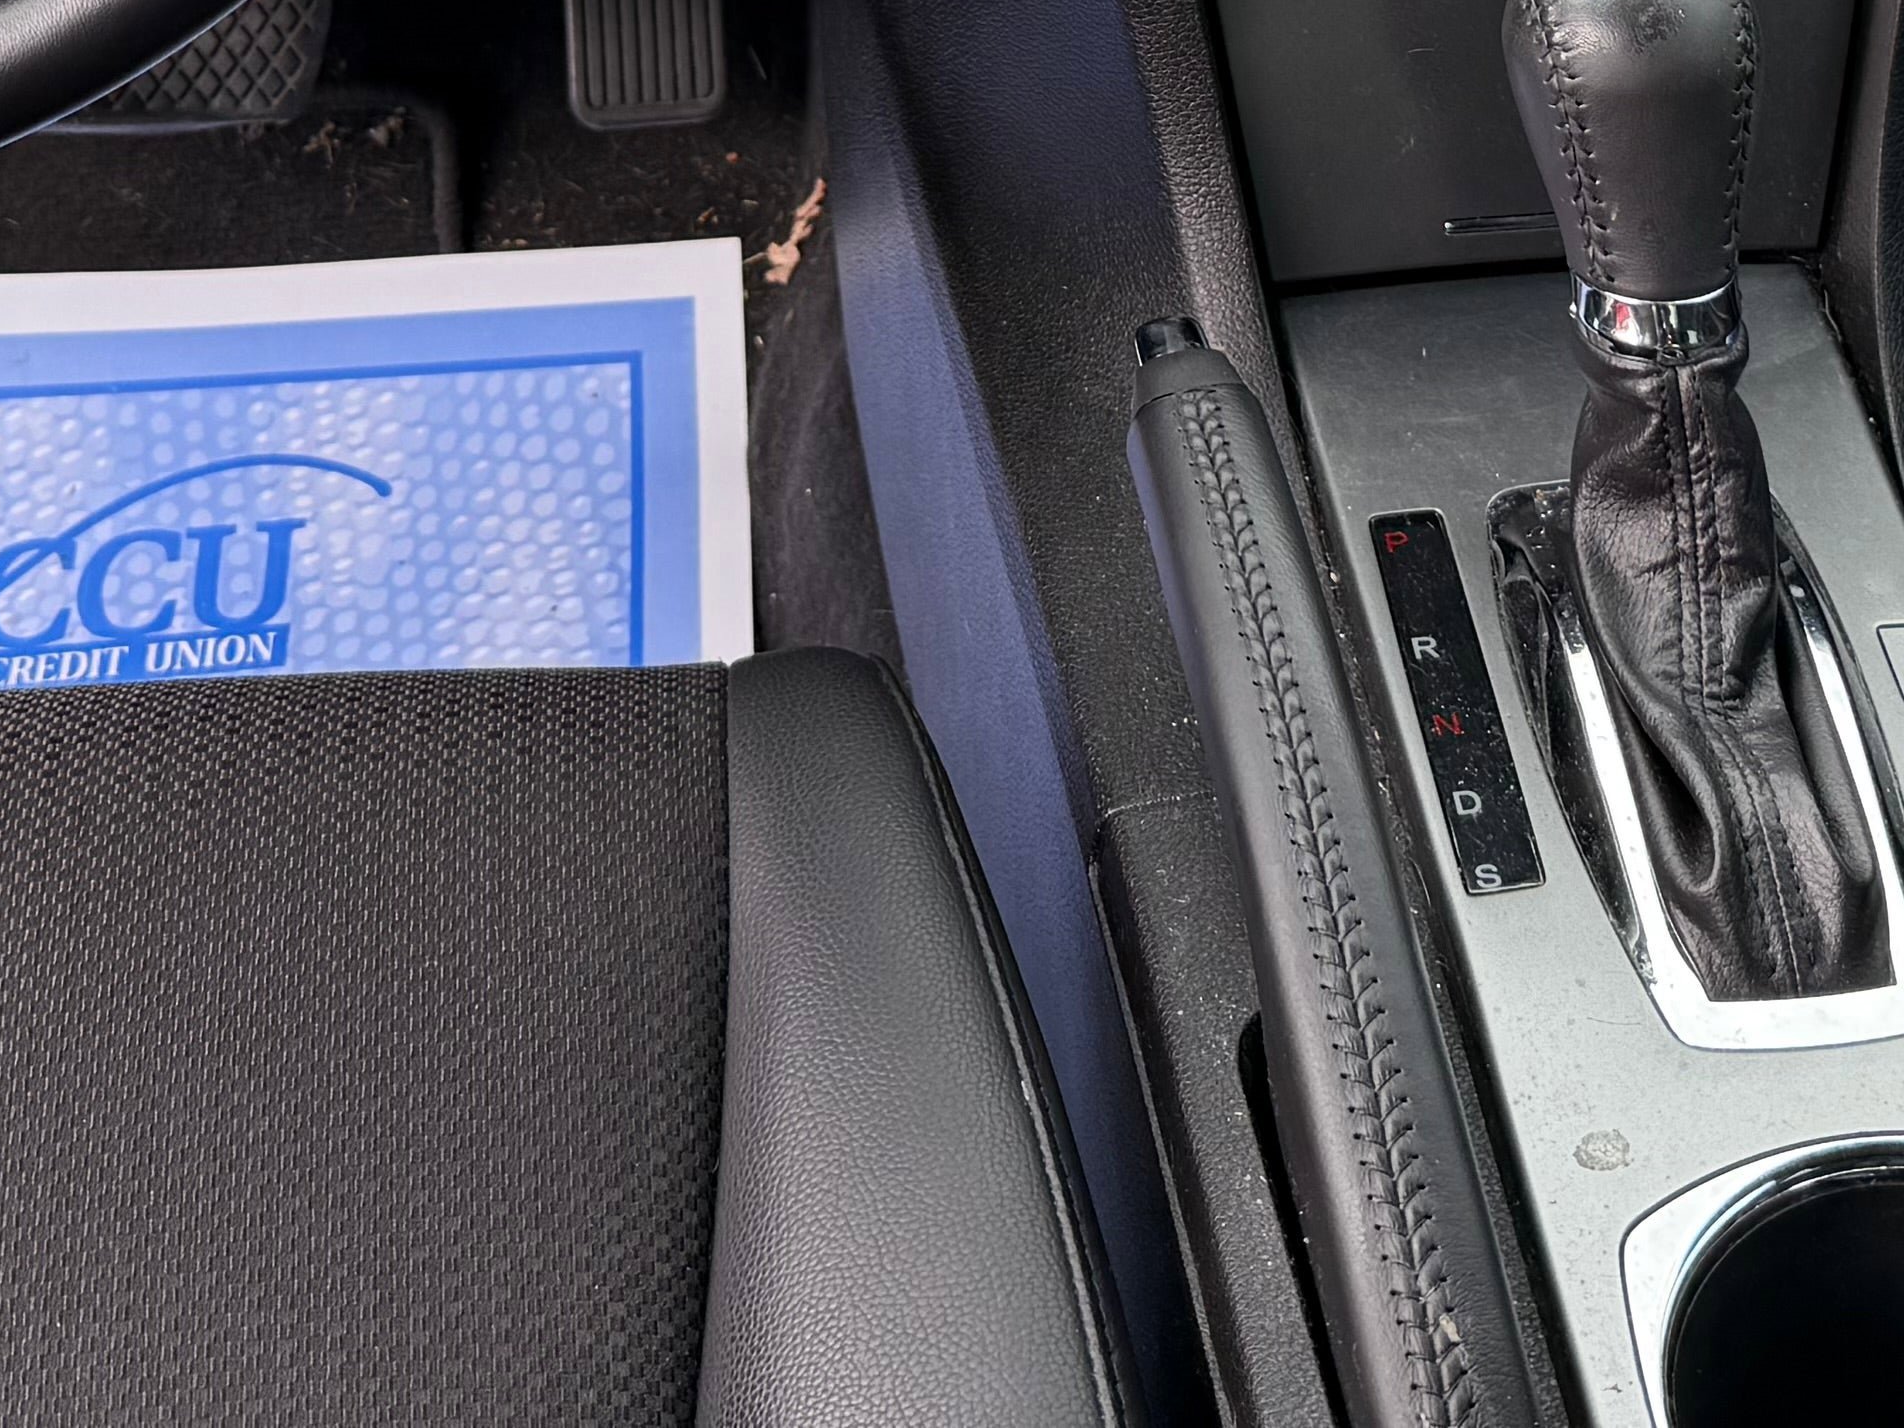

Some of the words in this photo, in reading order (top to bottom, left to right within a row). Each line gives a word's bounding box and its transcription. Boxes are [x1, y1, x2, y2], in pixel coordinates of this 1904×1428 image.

[1383, 531, 1409, 554] P
[144, 629, 278, 675] UNION
[1410, 636, 1441, 660] R
[1432, 711, 1465, 738] N
[1451, 790, 1484, 816] D
[1475, 863, 1502, 889] S
